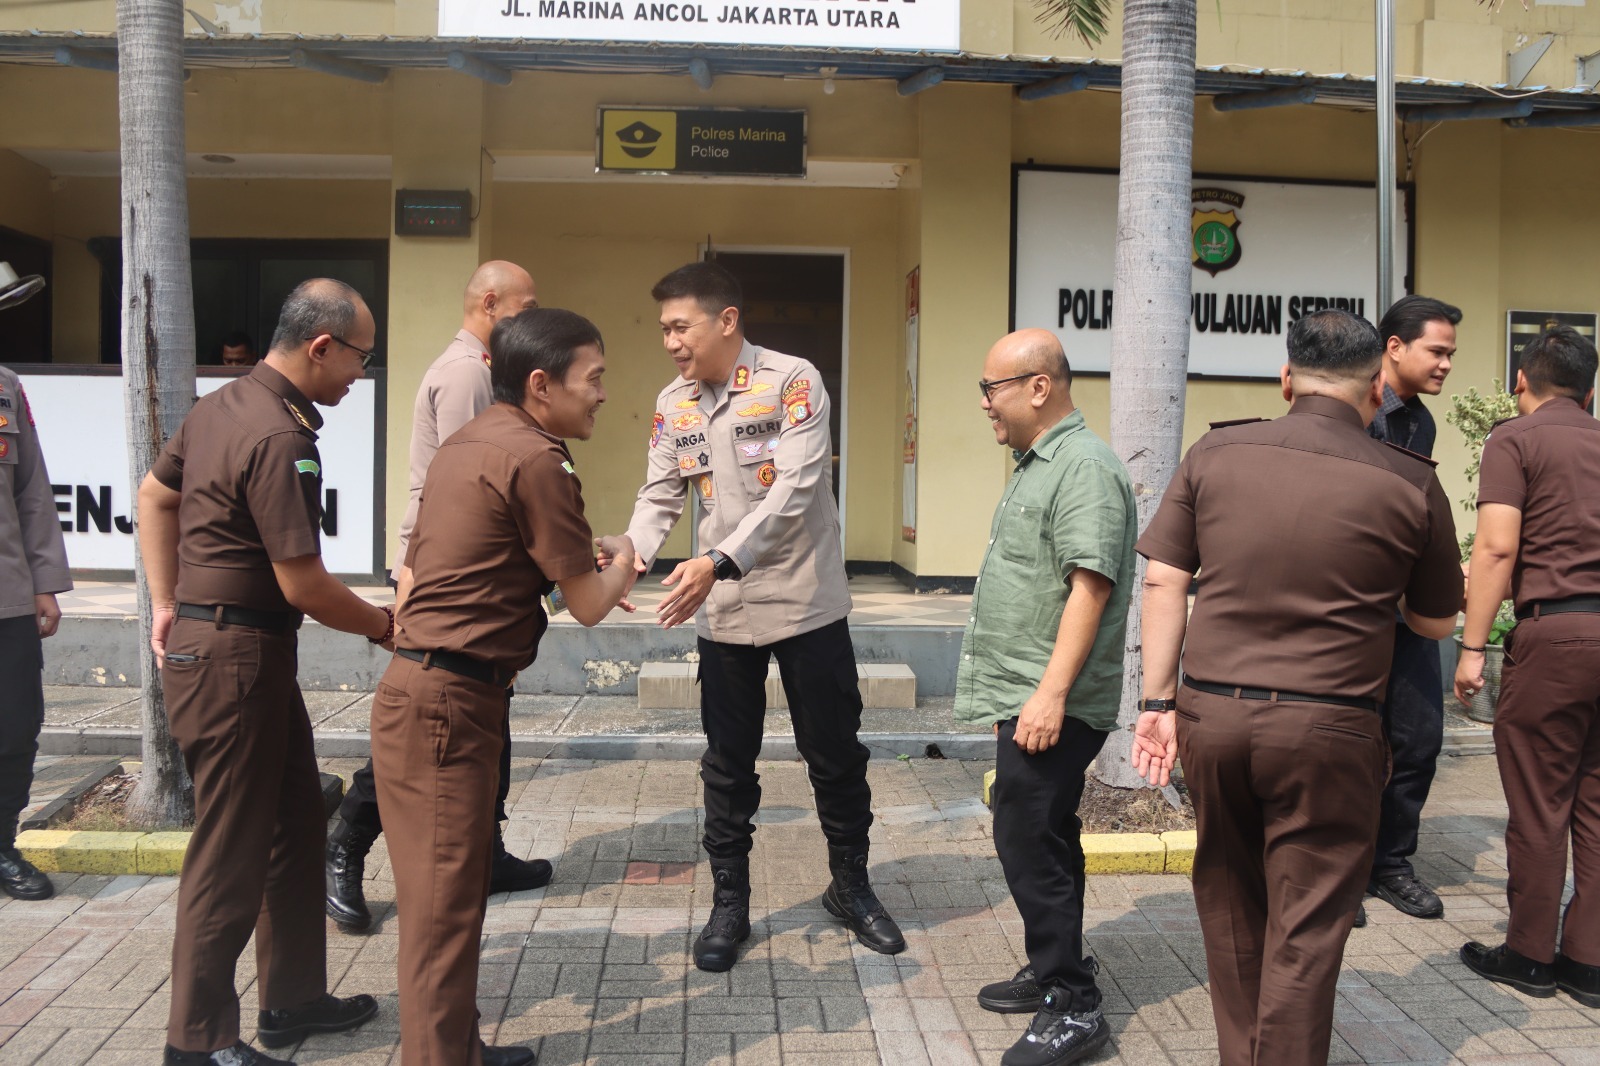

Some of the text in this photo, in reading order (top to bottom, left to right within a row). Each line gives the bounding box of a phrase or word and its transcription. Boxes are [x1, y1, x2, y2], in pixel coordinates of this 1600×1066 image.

[501, 0, 900, 29] JL. MARINA ANCOL JAKARTA UTARA
[691, 126, 786, 141] Polres Marina
[691, 145, 729, 158] Police
[1220, 192, 1240, 205] JAYA
[1058, 288, 1114, 330] POLR
[734, 421, 781, 438] POLRI
[675, 432, 706, 450] ARGA
